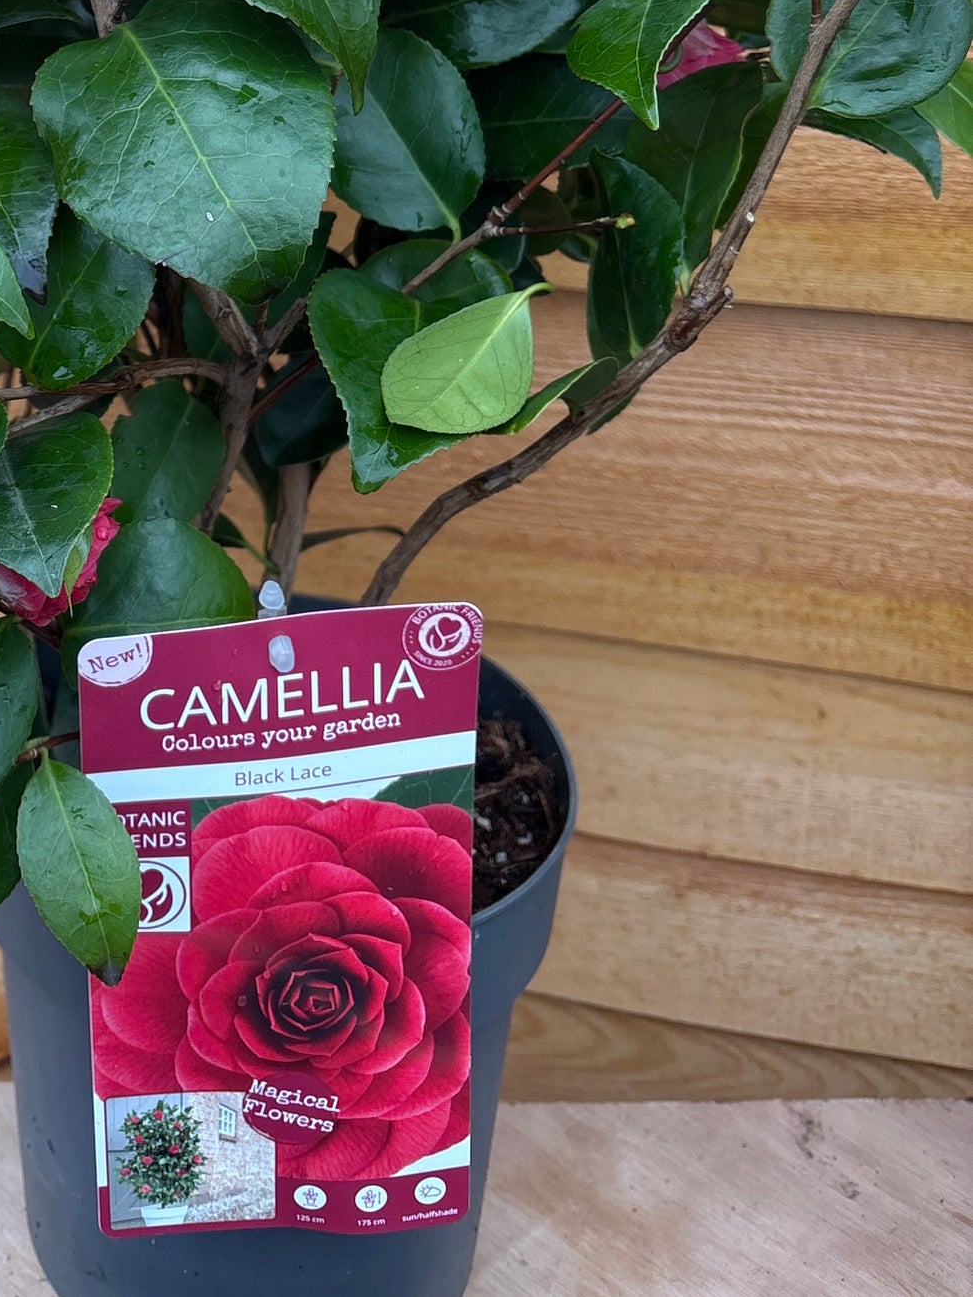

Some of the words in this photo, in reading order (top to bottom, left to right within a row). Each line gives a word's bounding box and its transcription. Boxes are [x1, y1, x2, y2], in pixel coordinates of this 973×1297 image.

[87, 643, 143, 674] New!
[413, 650, 433, 665] SINCE
[139, 659, 425, 731] CAMELLIA
[162, 731, 256, 752] Colours
[262, 724, 317, 749] your
[323, 711, 401, 740] garden
[234, 769, 284, 787] Black
[290, 763, 332, 781] Lace
[117, 810, 186, 829] TANIC
[130, 831, 186, 848] ENDS
[249, 1079, 340, 1113] Magical
[243, 1098, 335, 1134] Flowers
[296, 1213, 311, 1223] 125
[312, 1216, 325, 1224] cm
[357, 1219, 372, 1227] 175
[372, 1217, 386, 1226] cm
